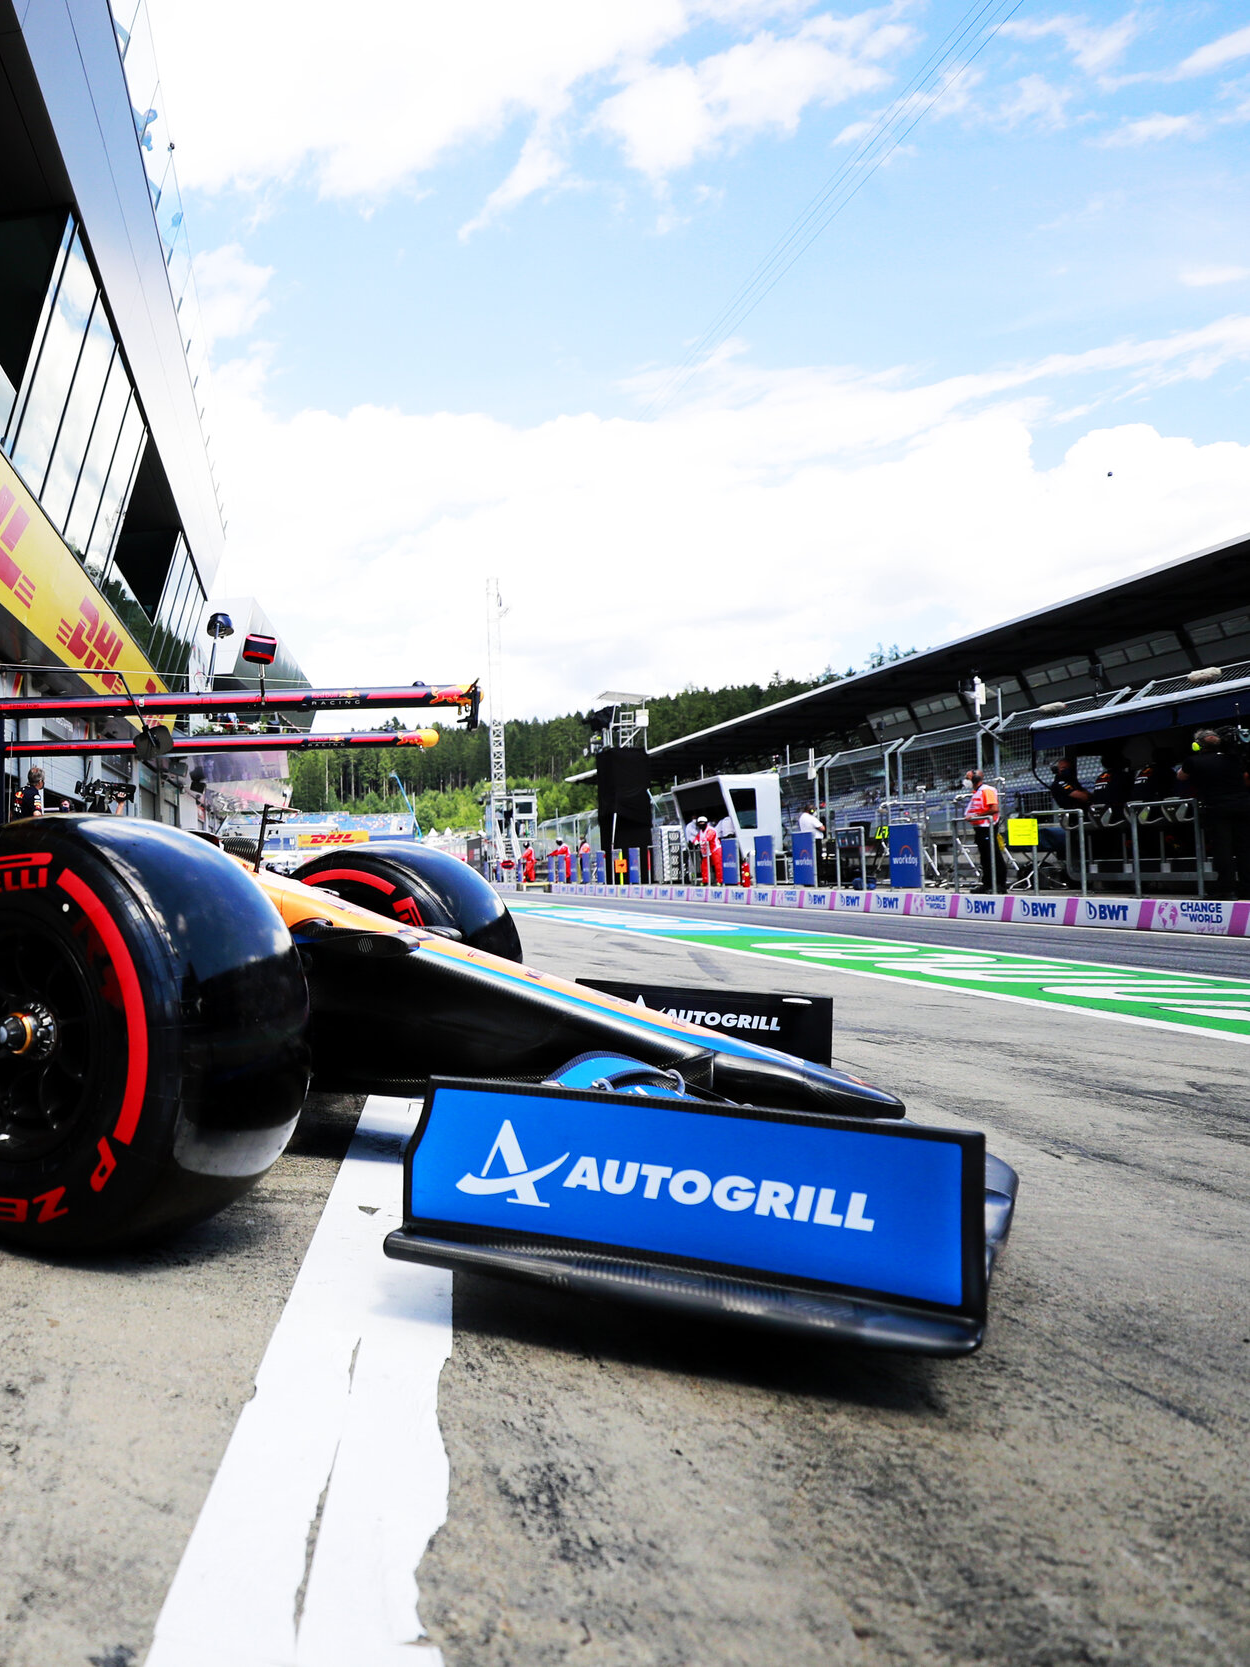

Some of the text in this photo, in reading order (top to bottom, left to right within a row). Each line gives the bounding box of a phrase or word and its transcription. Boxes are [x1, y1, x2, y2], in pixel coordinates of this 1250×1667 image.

[67, 595, 124, 691] DHL
[310, 833, 355, 844] DHL
[892, 854, 918, 867] workday
[813, 894, 826, 905] BWT
[845, 895, 860, 907] BWT
[882, 897, 900, 910] BWT
[974, 901, 996, 914] BWT
[1031, 902, 1057, 917] BWT
[1099, 905, 1129, 921] BWT
[1180, 902, 1223, 914] CHANGE
[1189, 913, 1223, 924] WORLD
[666, 1008, 781, 1031] AUTOGRILL
[563, 1155, 876, 1232] AUTOGRILL
